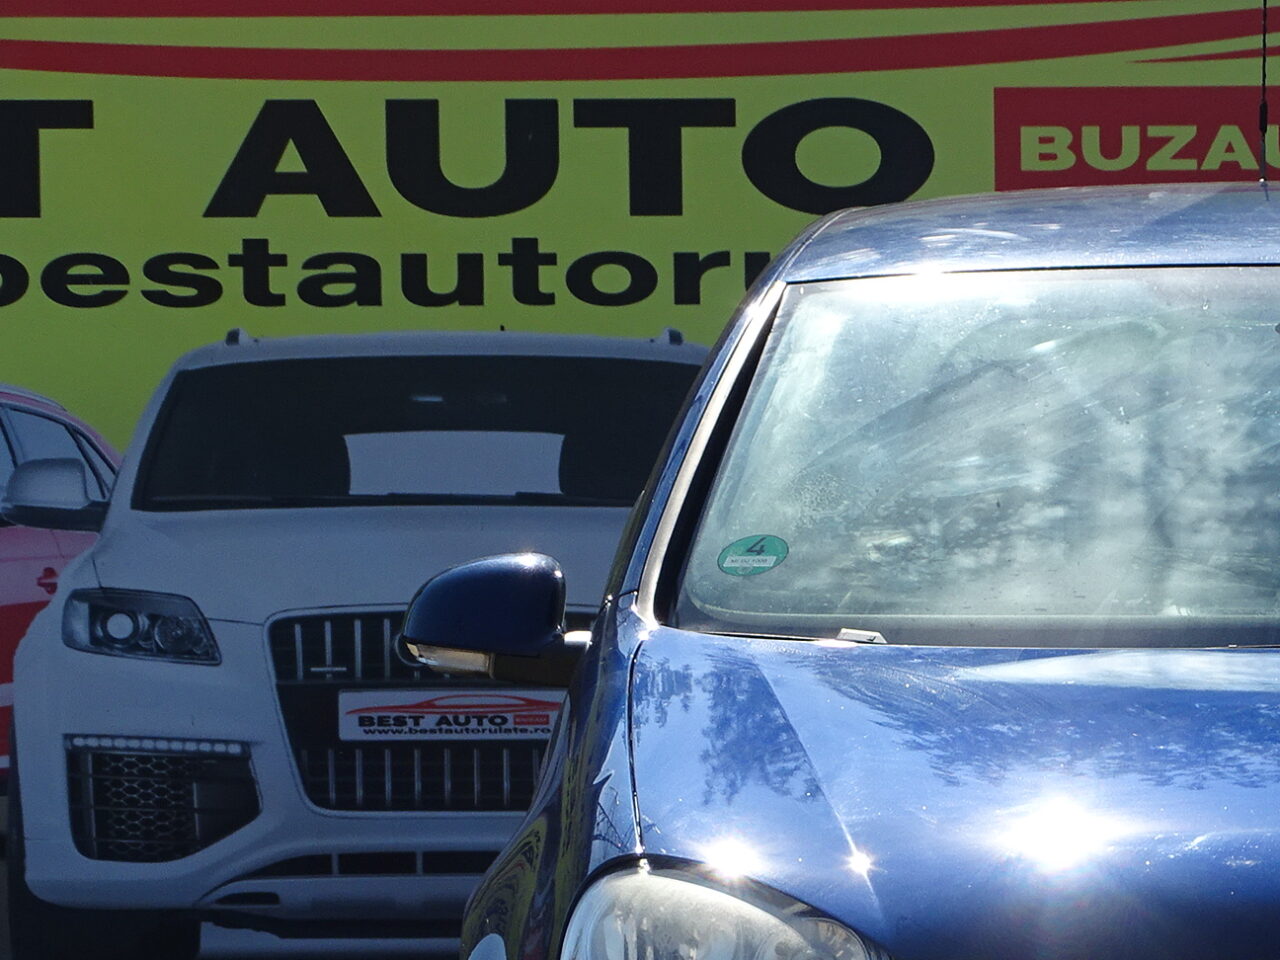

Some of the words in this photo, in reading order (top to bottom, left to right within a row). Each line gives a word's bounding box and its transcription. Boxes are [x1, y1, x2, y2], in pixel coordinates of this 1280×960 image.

[202, 97, 934, 218] AUTO
[746, 536, 767, 555] 4
[357, 714, 425, 727] BEST
[435, 714, 509, 727] AUTO
